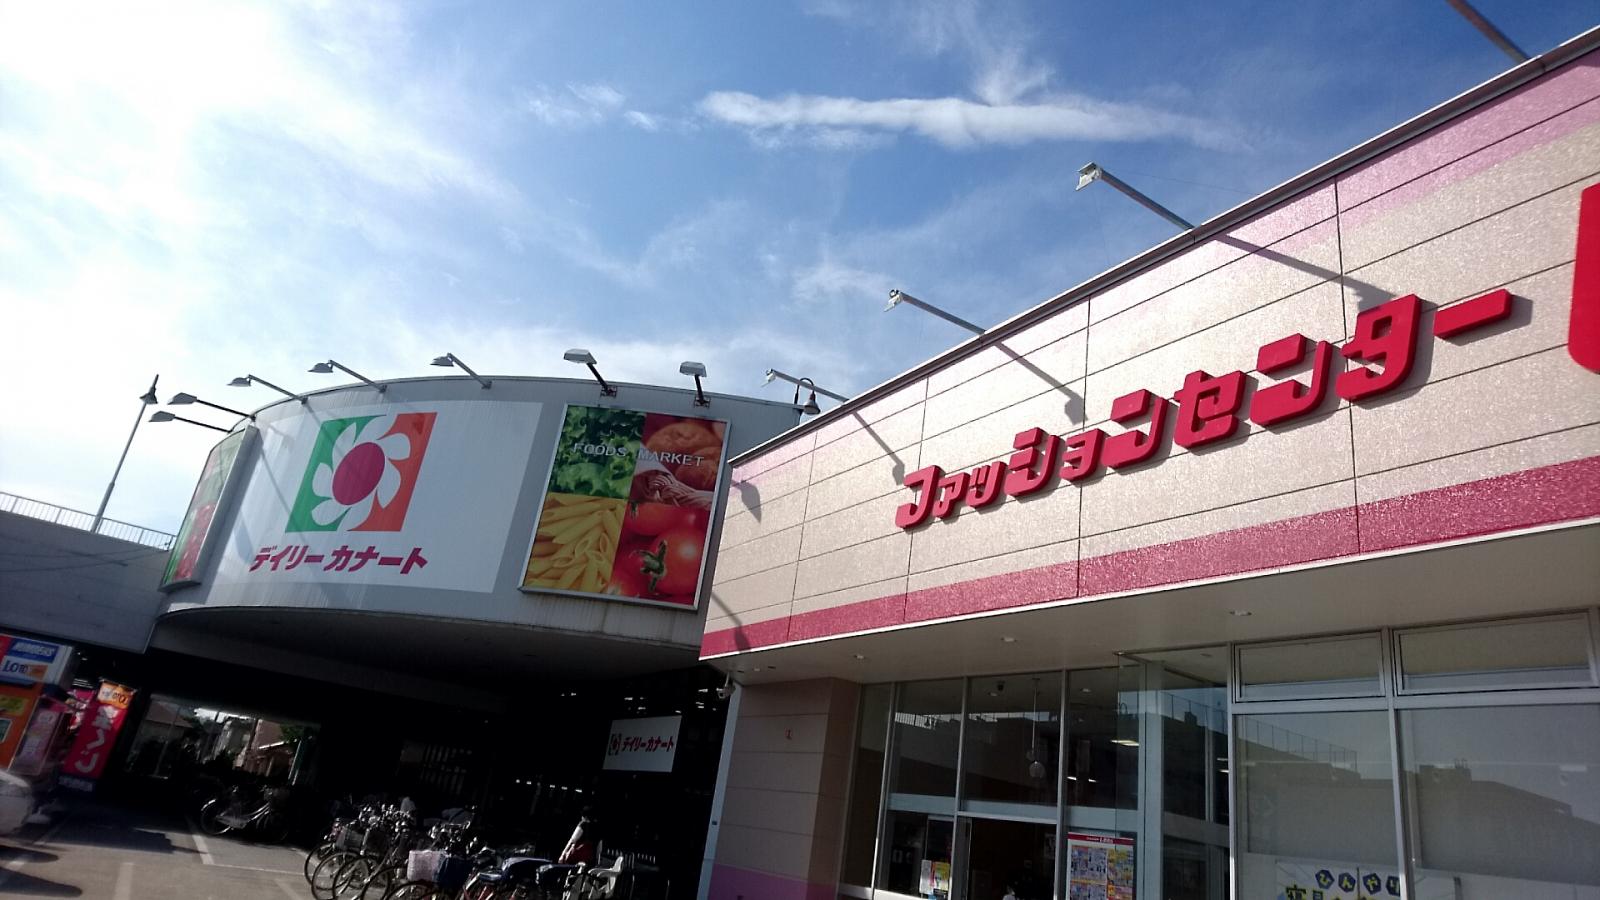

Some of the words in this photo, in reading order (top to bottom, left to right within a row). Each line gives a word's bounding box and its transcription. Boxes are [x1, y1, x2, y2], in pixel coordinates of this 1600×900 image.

[895, 289, 1514, 528] ファッションセンター
[573, 442, 628, 457] FOODS
[636, 447, 705, 467] MARKET
[249, 545, 428, 575] デイリーカナート
